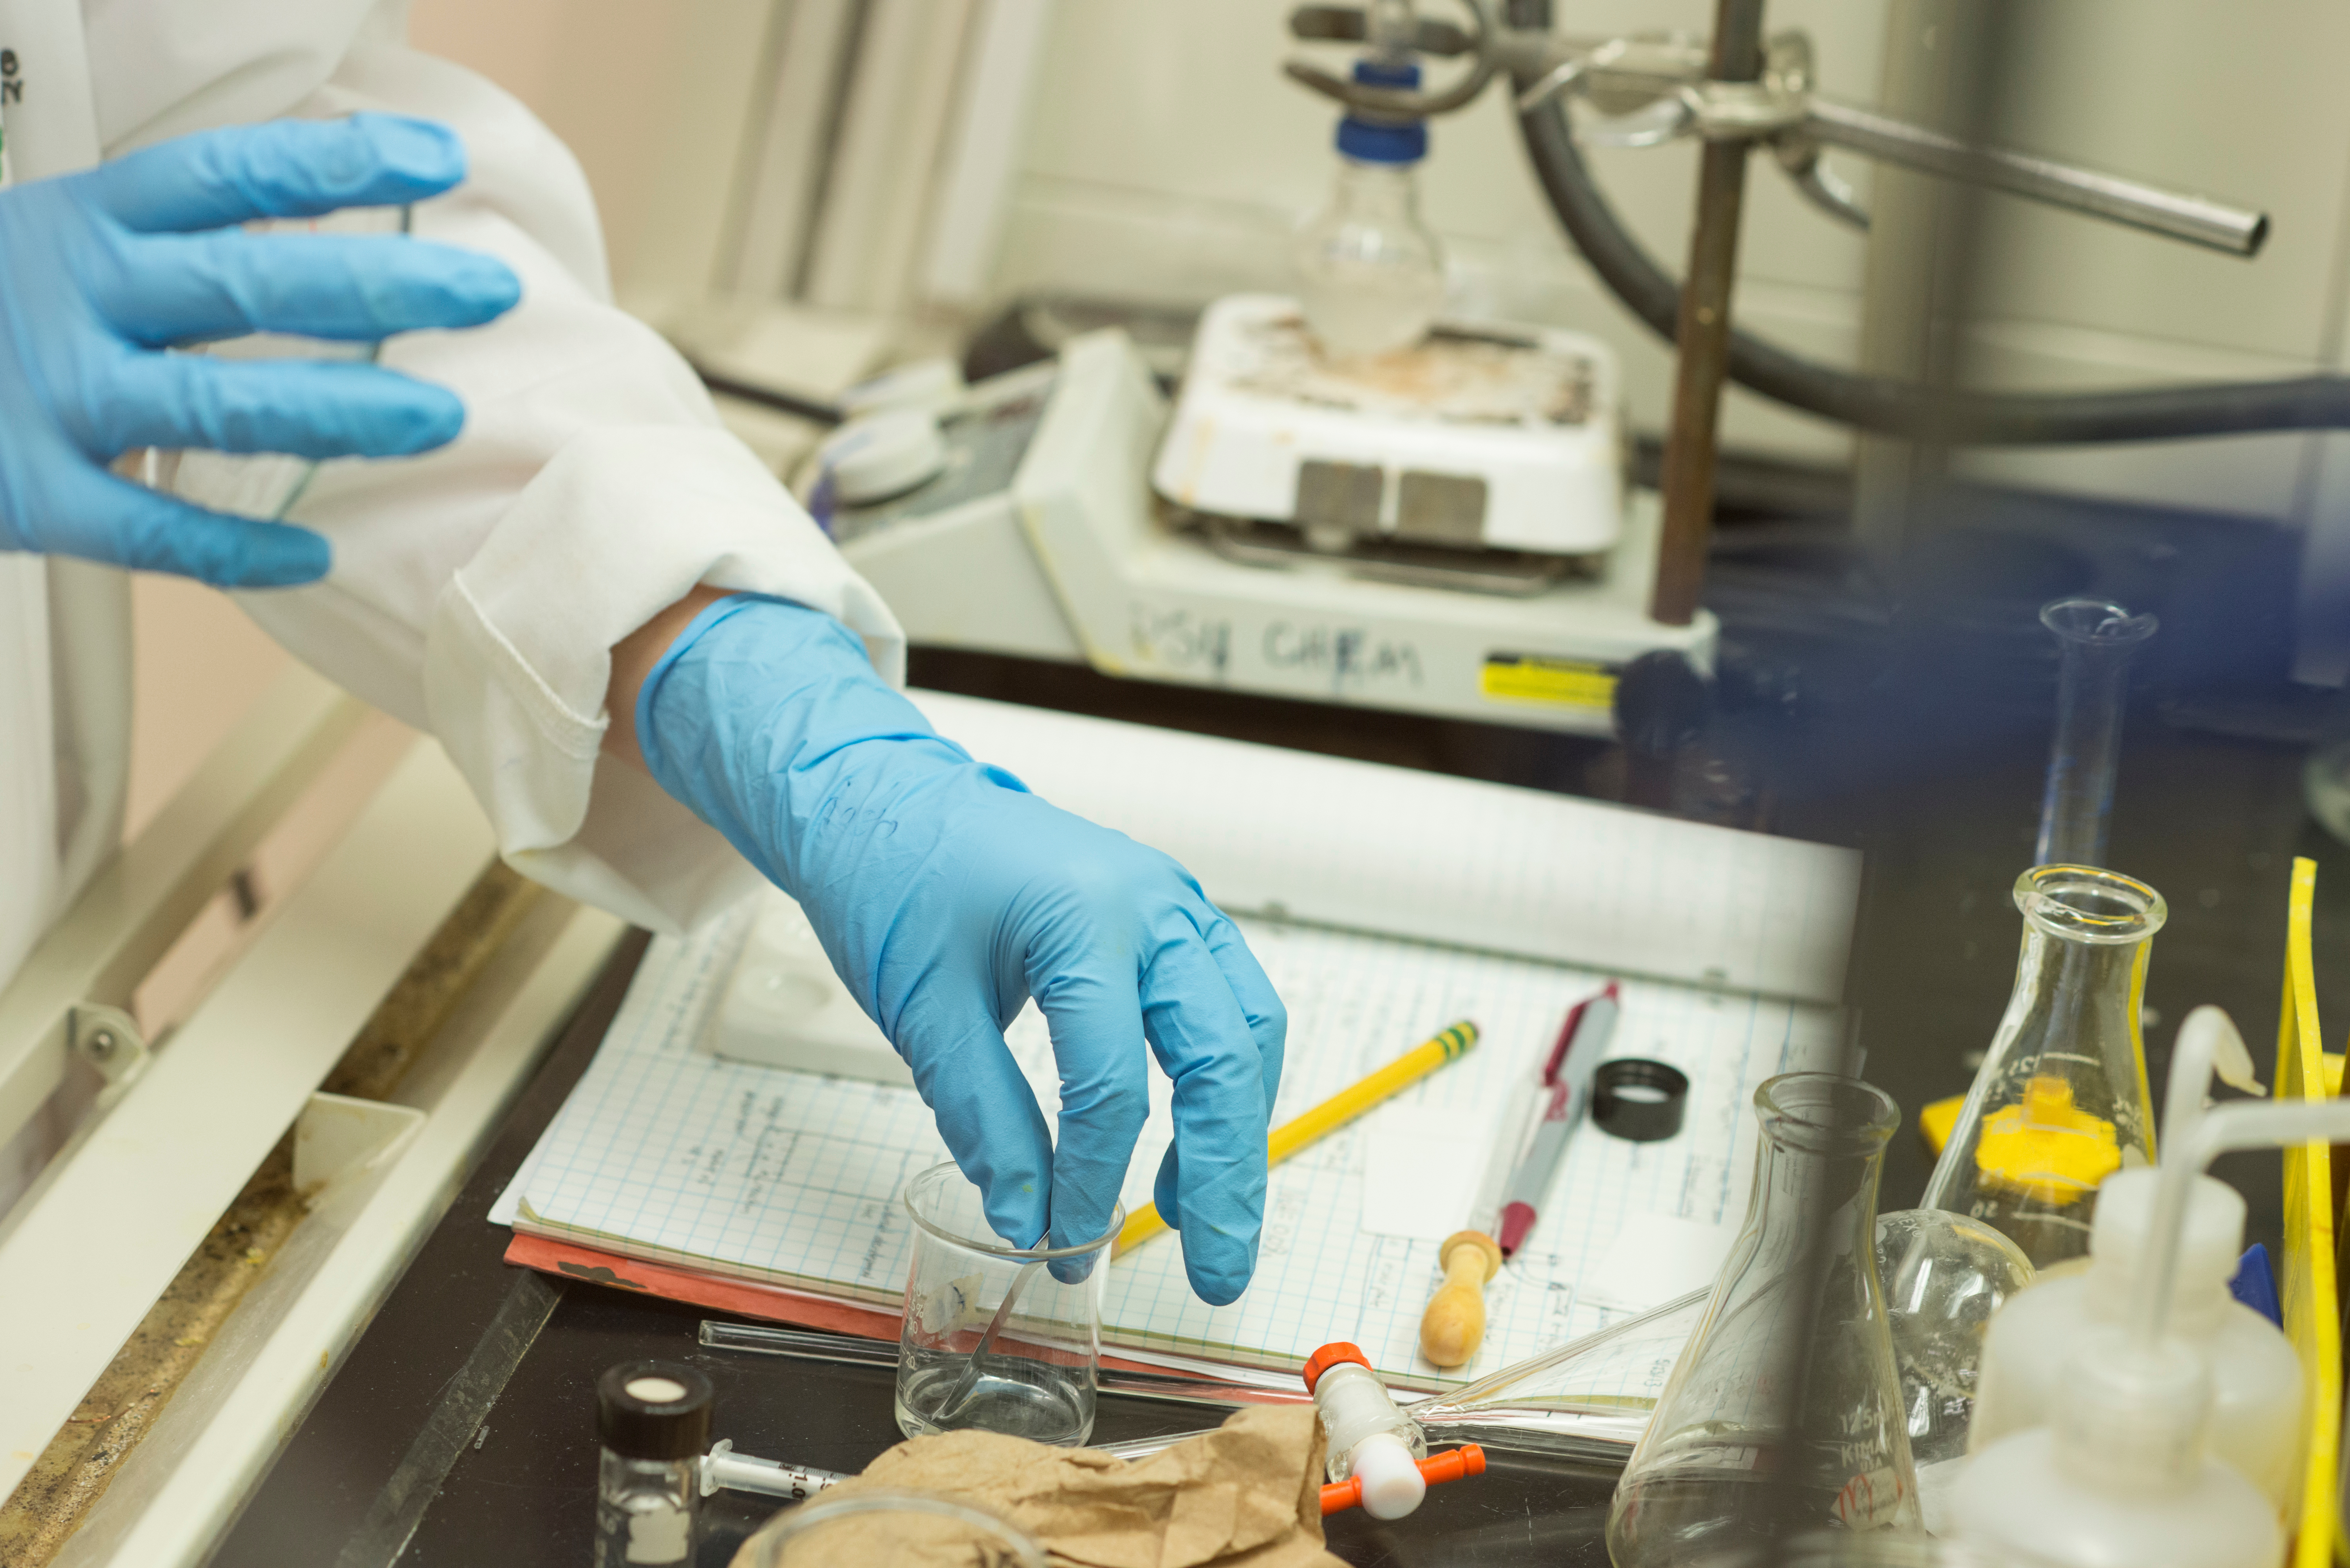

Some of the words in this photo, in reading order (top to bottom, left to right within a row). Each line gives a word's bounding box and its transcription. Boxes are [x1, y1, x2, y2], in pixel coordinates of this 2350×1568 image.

[908, 1317, 918, 1334] 30
[906, 1351, 915, 1369] 20
[1841, 1431, 1893, 1468] KIMAX
